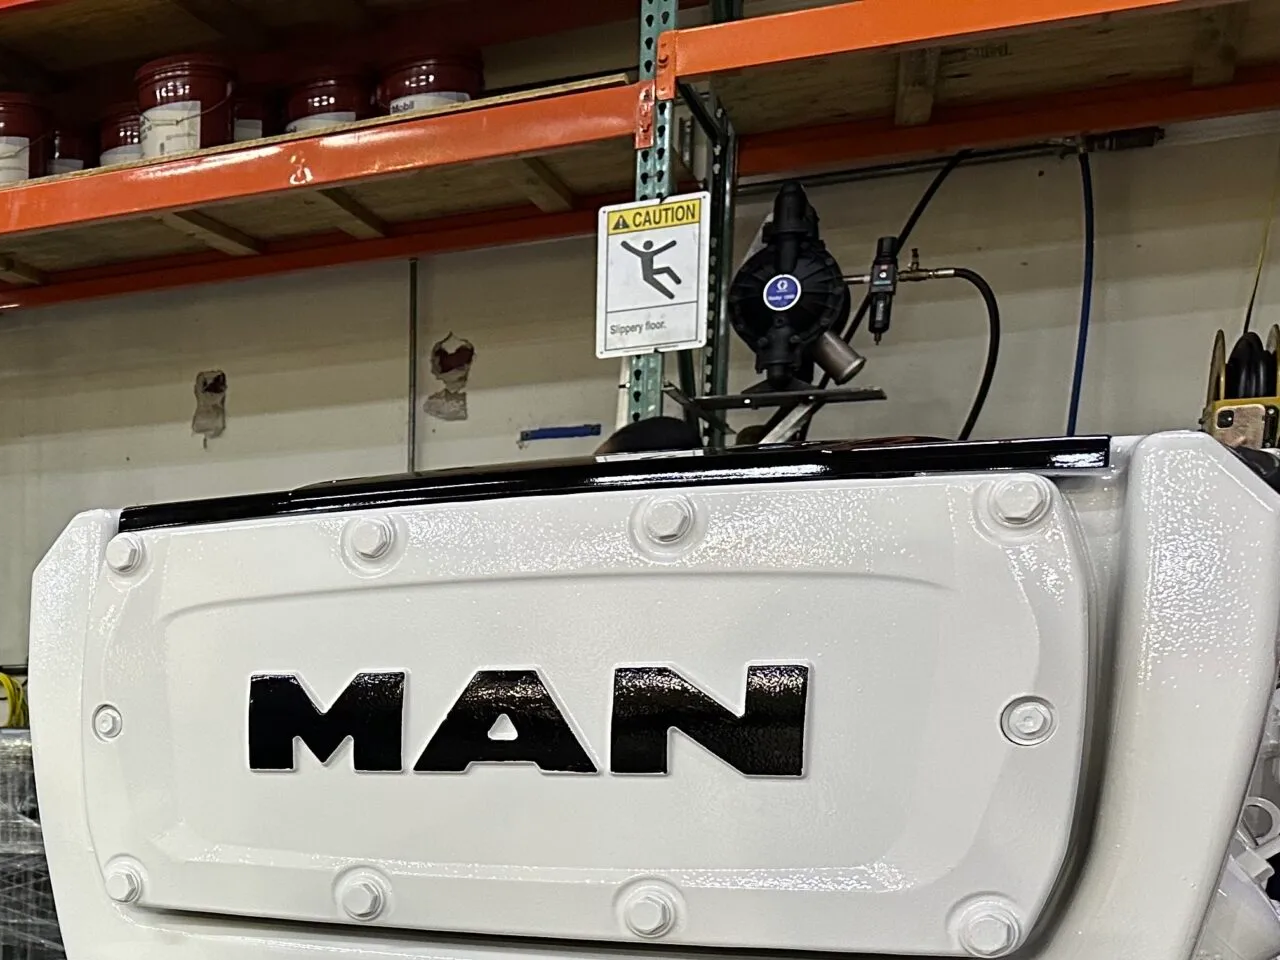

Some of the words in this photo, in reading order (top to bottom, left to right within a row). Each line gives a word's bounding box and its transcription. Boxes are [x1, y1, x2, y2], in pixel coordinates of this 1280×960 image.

[632, 203, 697, 228] CAUTION
[610, 322, 643, 336] Slippery
[645, 319, 667, 331] floor.
[248, 664, 809, 776] MAN
